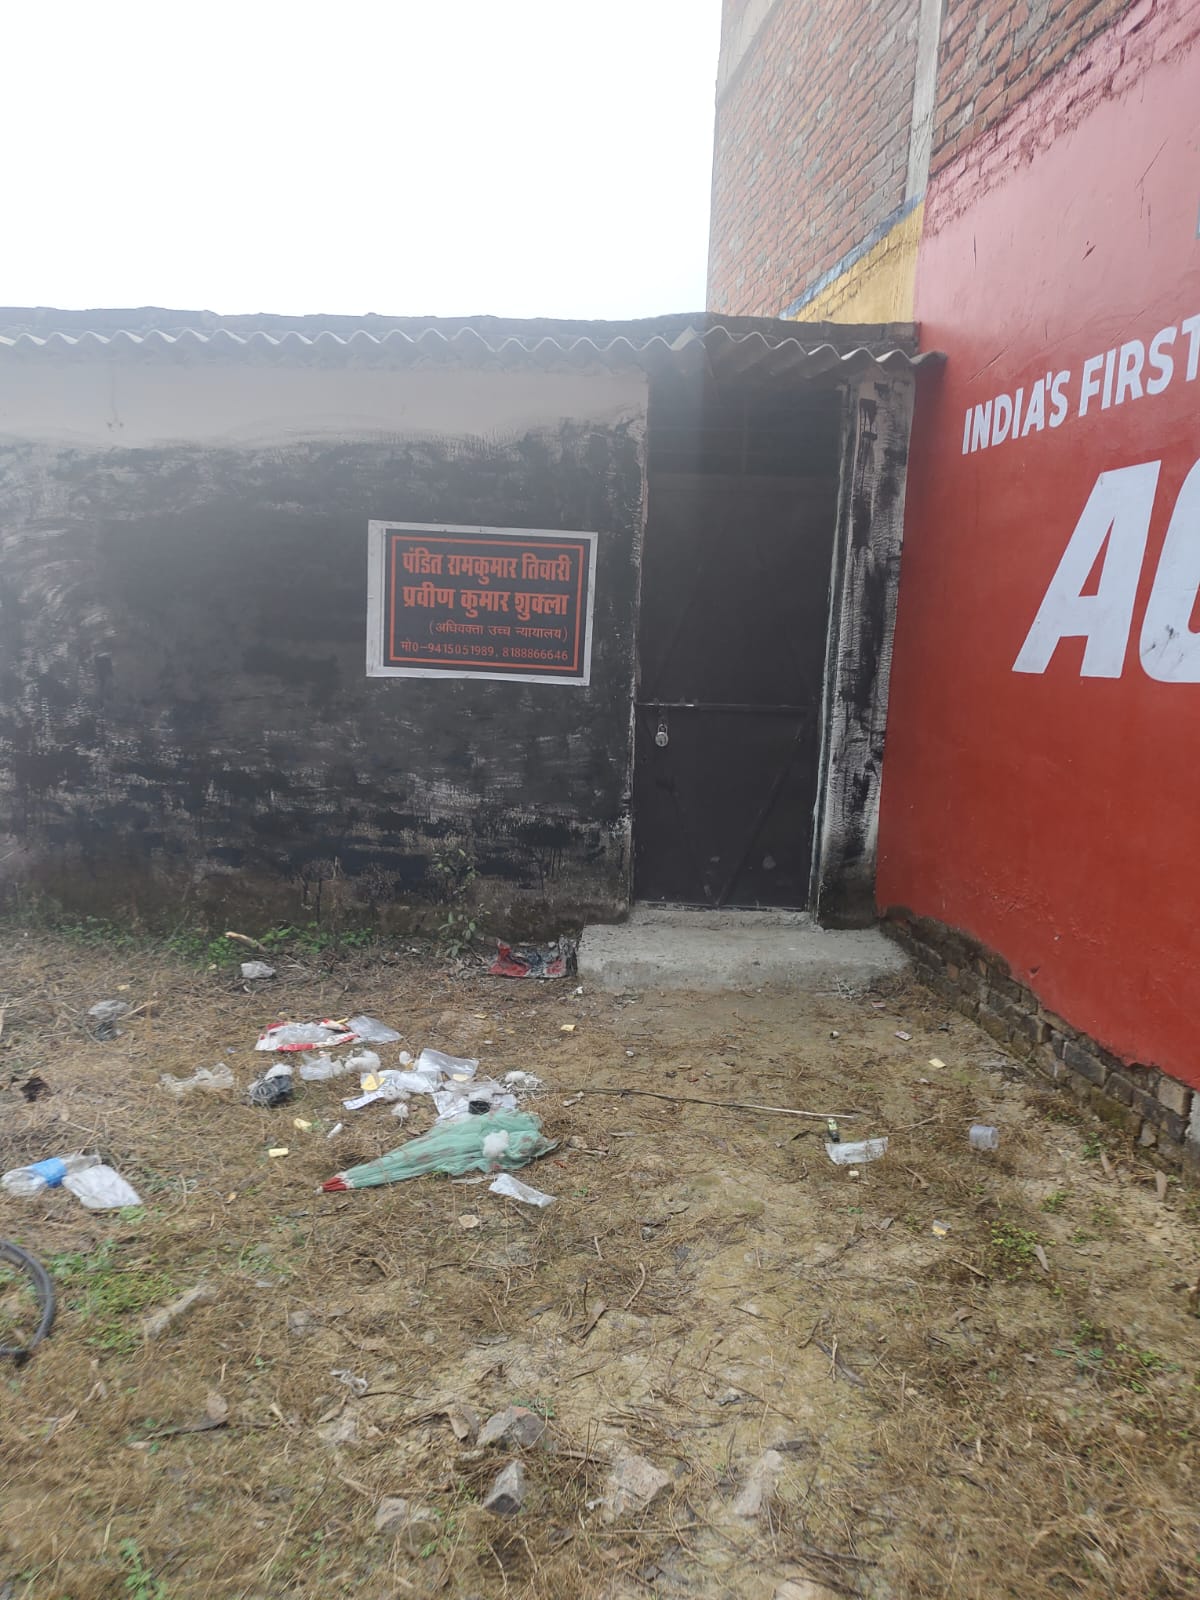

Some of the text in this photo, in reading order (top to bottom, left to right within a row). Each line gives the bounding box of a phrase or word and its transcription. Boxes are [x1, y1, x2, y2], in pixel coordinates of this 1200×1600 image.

[961, 369, 1071, 456] INDIA'S
[401, 546, 572, 585] पंडित रामकुमार तिवारी
[402, 581, 569, 621] प्रवीण कुमार शुक्ला
